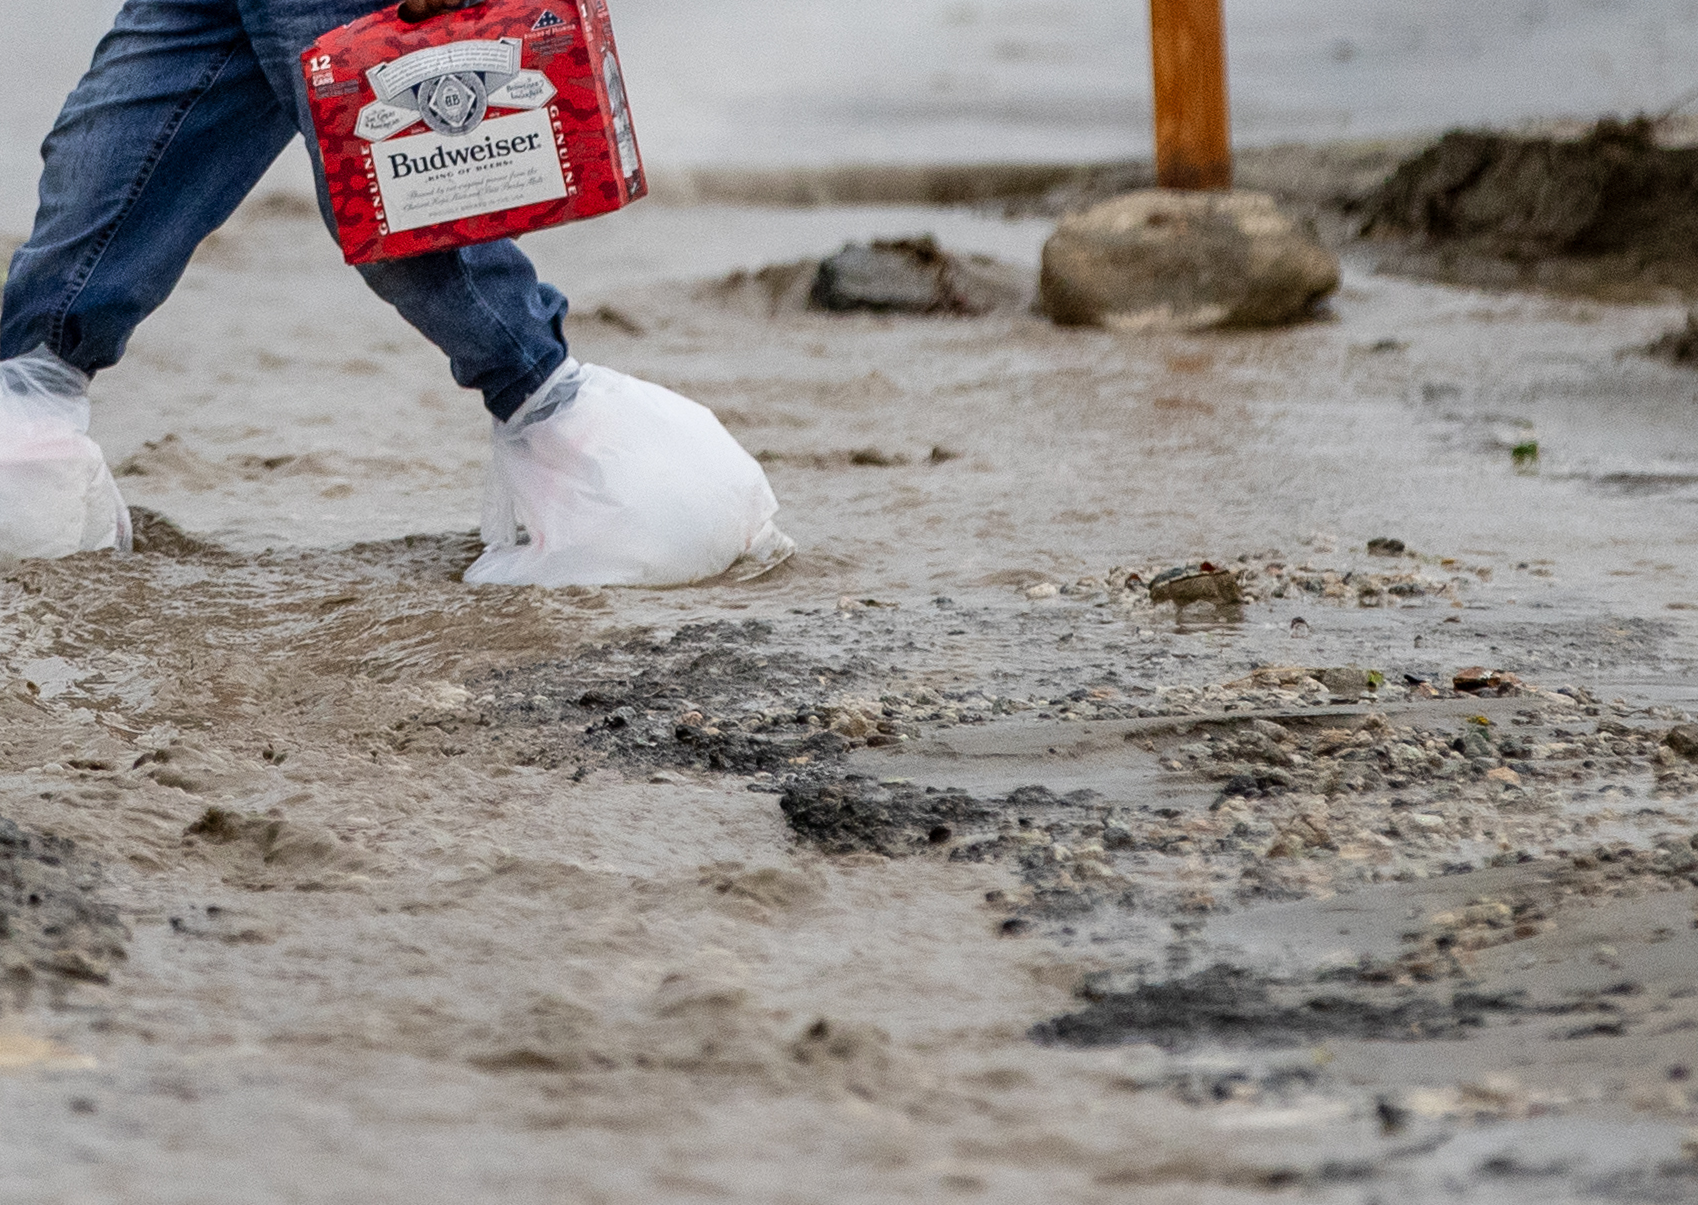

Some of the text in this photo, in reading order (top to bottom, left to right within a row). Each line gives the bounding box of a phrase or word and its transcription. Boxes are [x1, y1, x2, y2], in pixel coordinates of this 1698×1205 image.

[310, 55, 331, 72] 12
[388, 132, 539, 179] Budweiser
[550, 105, 577, 196] GENUINE
[360, 145, 389, 236] GENUINE
